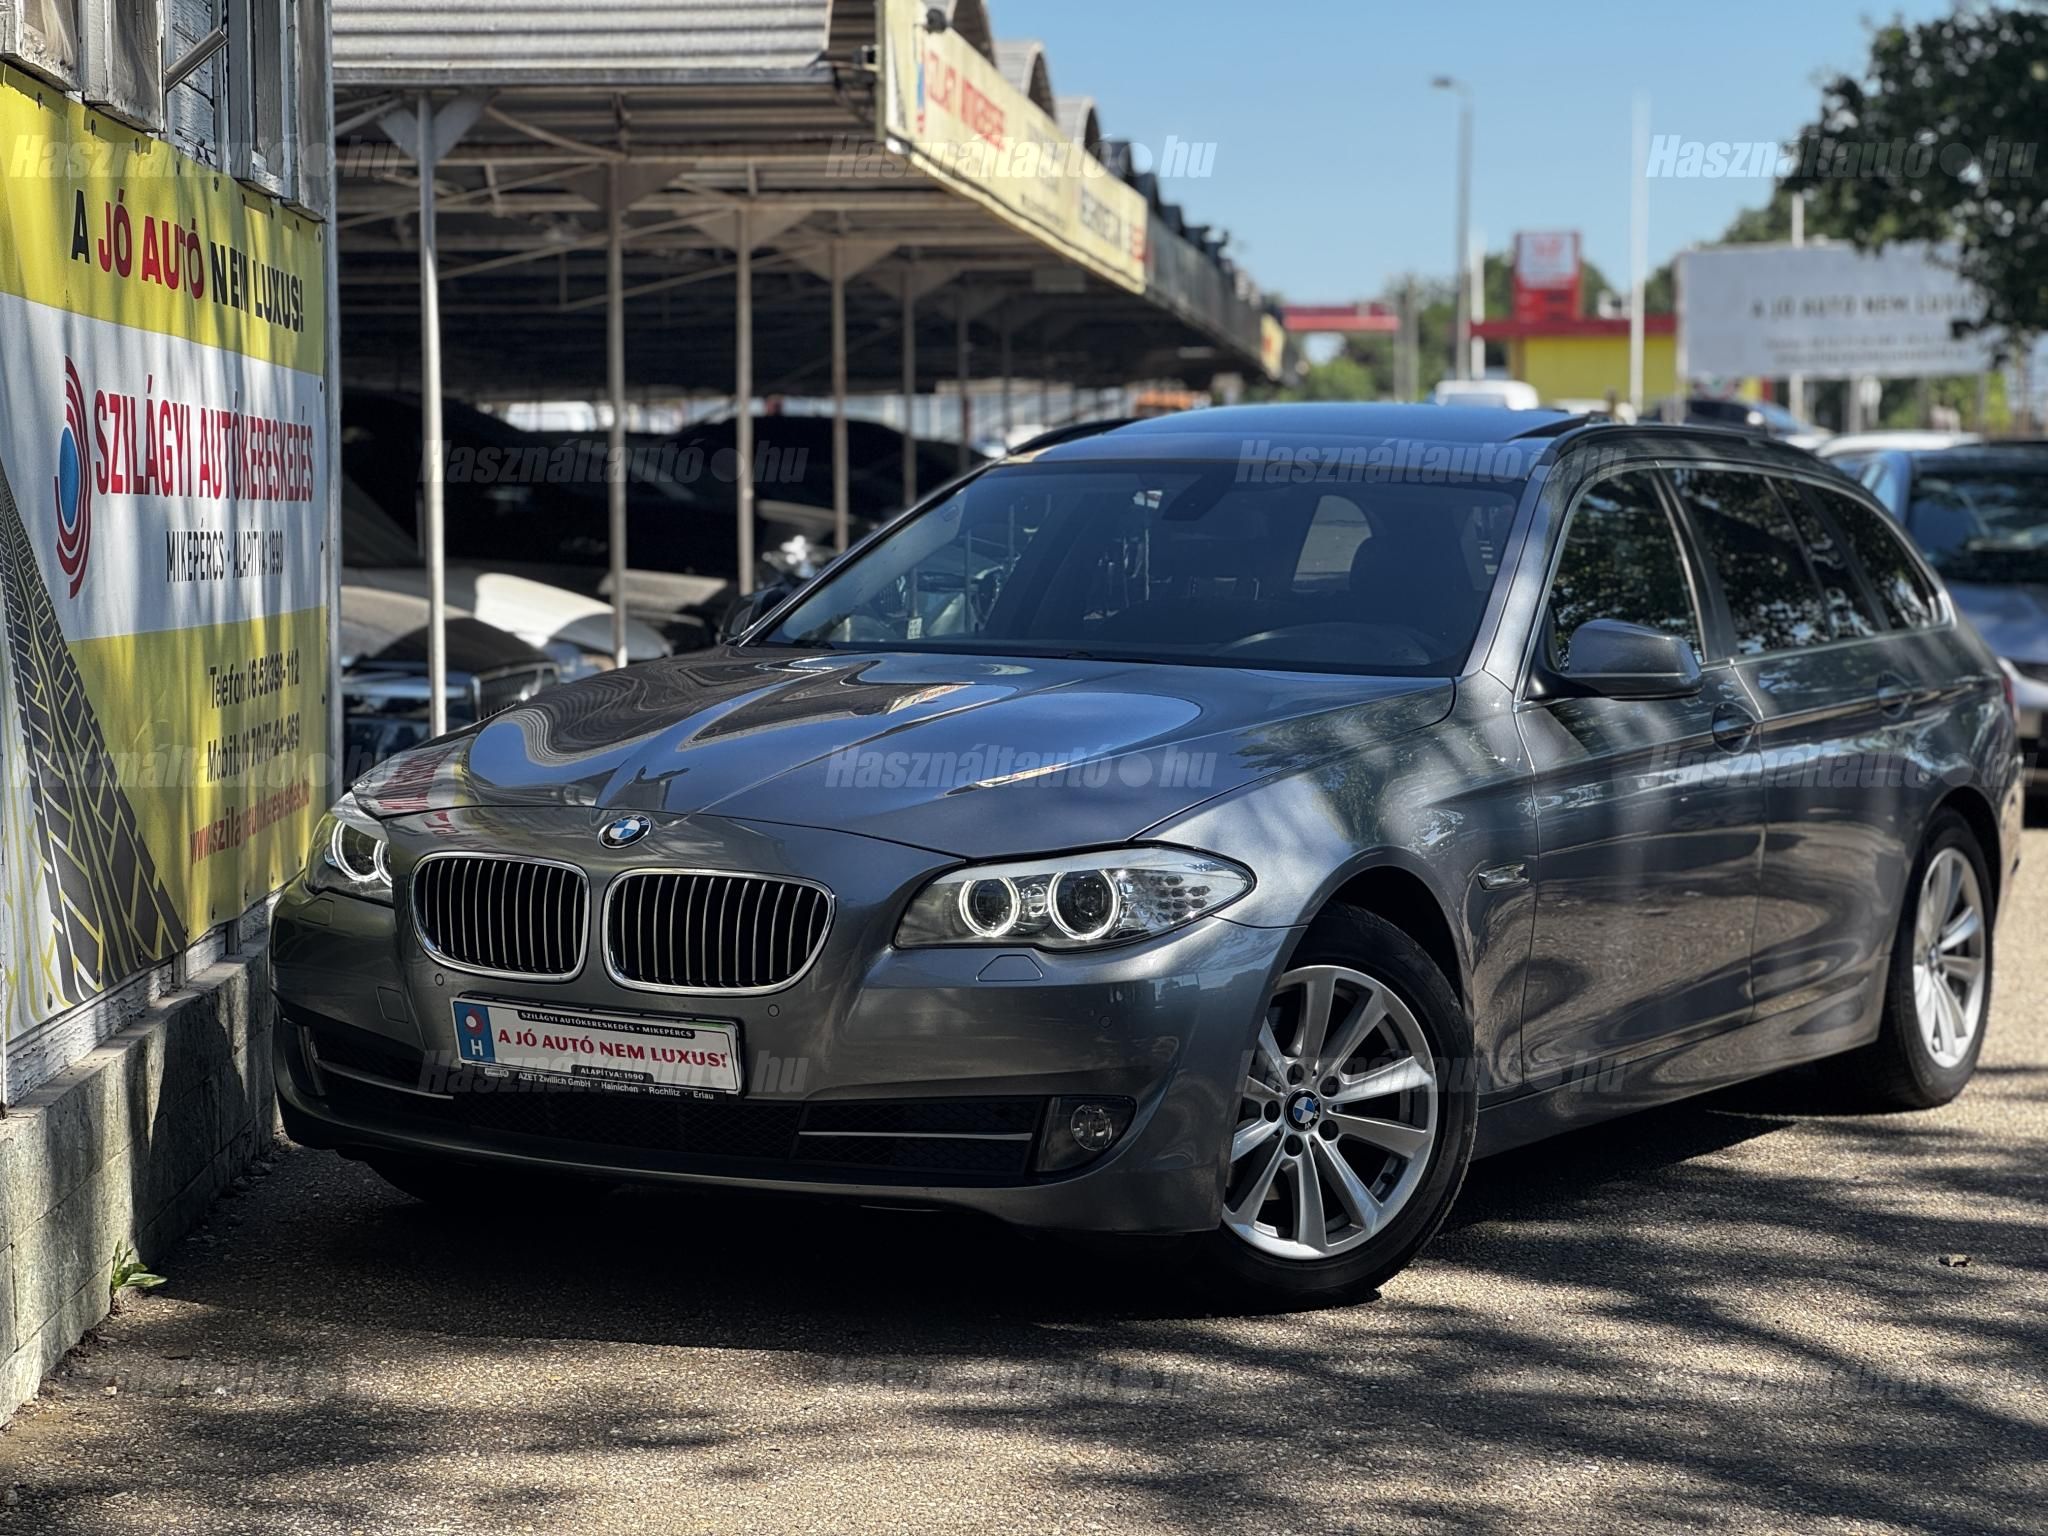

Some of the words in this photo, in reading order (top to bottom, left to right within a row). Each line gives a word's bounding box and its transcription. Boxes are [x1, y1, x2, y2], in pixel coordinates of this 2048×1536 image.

[71, 189, 90, 264] A
[98, 188, 132, 278] JÓ
[141, 214, 204, 300] AUTÓ
[210, 241, 249, 314] NEM
[252, 260, 304, 332] LUXUS!
[94, 374, 191, 497] SZILÁGYI
[199, 390, 313, 502] AUTÓKERESKEDÉS
[166, 517, 224, 582] MIKEPÉRCS
[269, 530, 283, 576] 1990
[207, 734, 240, 782] Mobil:
[521, 1011, 558, 1022] SZILÁGYI
[560, 1016, 635, 1032] AUTÓKERESKEDÉS
[642, 1026, 692, 1037] MIKEPÉRCS
[470, 1039, 483, 1056] H
[498, 1029, 511, 1044] A
[515, 1028, 537, 1047] JÓ
[542, 1035, 594, 1054] AUTÓ
[599, 1041, 645, 1060] NEM
[650, 1047, 727, 1068] LUXUS!
[518, 1072, 537, 1082] AZET
[539, 1074, 567, 1085] Zwillich
[568, 1077, 591, 1088] GmbH
[601, 1081, 639, 1093] Hainichen
[648, 1086, 680, 1097] Rochlitz
[693, 1090, 714, 1100] Erlau
[581, 1067, 622, 1079] ALAPÍTVA:
[624, 1072, 644, 1081] 1990
